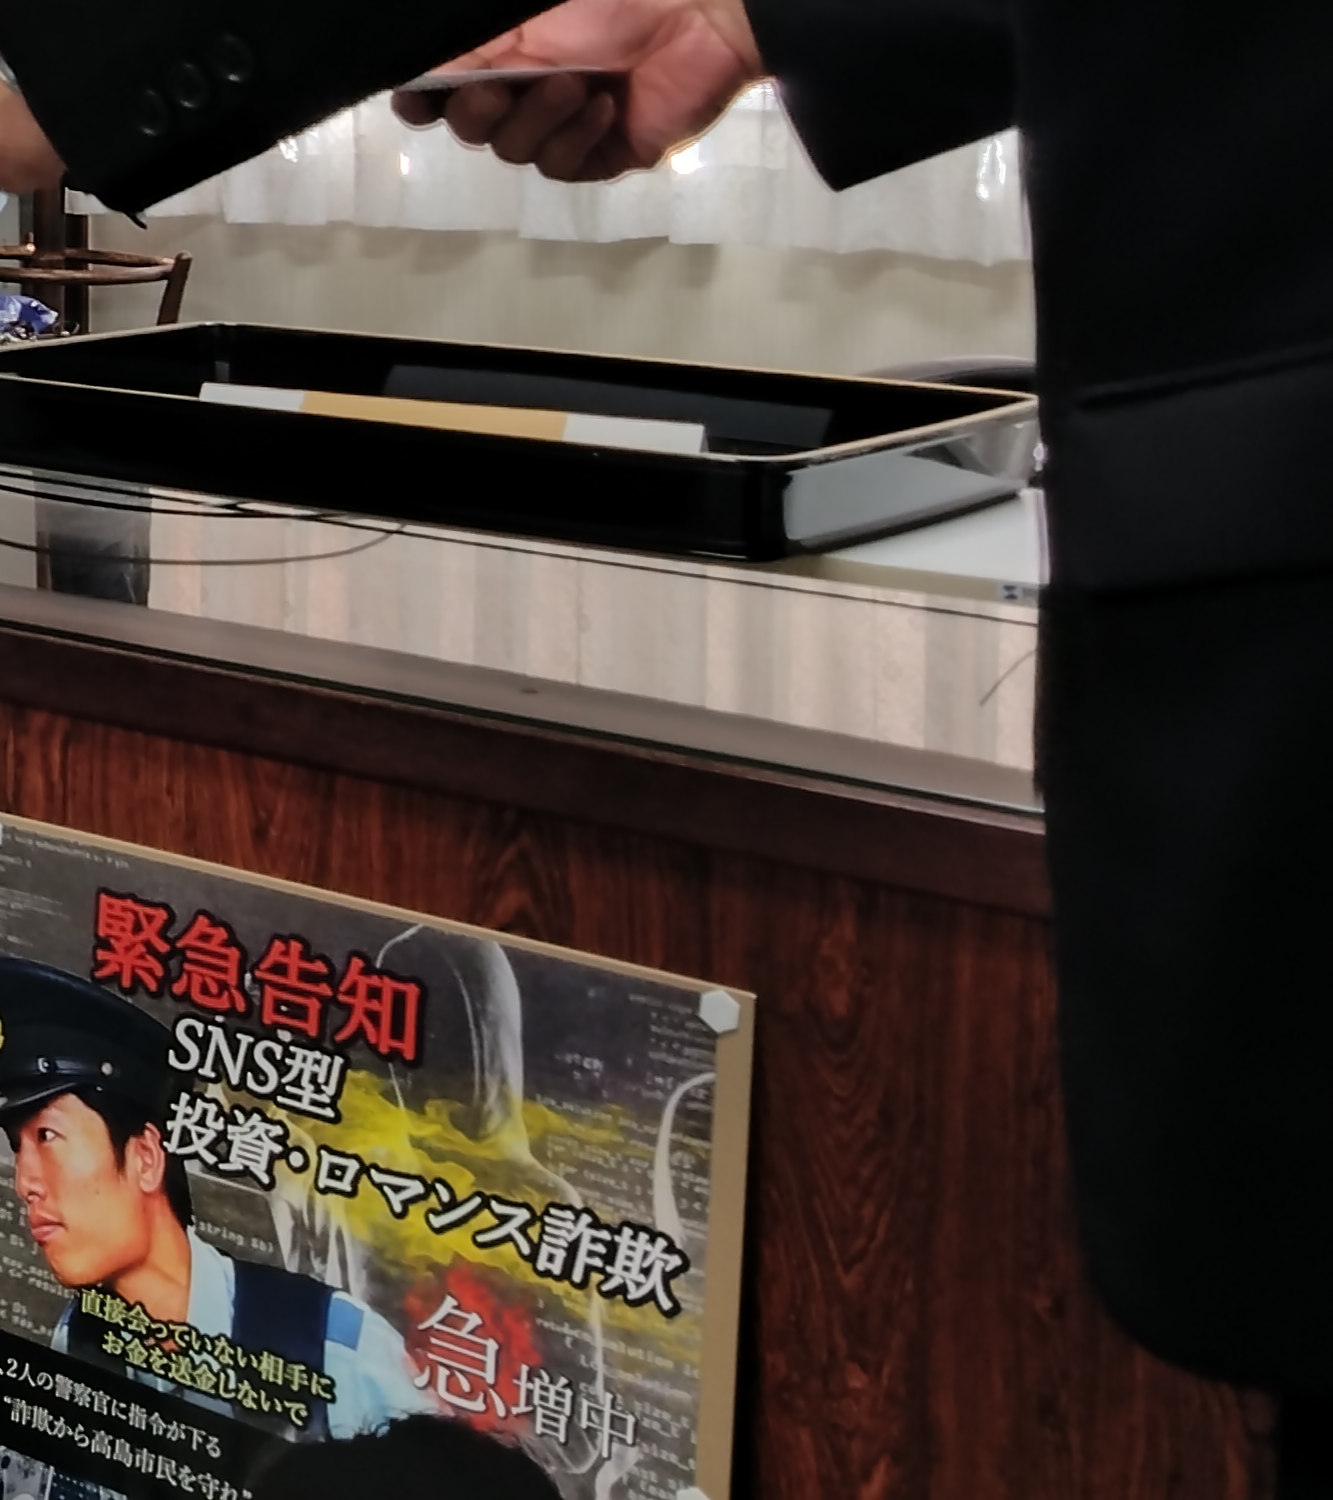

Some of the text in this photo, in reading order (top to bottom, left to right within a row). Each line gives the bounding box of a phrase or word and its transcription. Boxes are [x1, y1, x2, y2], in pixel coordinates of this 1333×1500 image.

[93, 891, 422, 1063] 緊急告知
[167, 1017, 346, 1119] SNS型
[162, 1092, 686, 1312] 投資・ロマンス詐欺
[80, 1287, 334, 1400] 直接会っていない相手に
[101, 1329, 310, 1427] お金を送金しないで
[413, 1293, 637, 1459] 急増中
